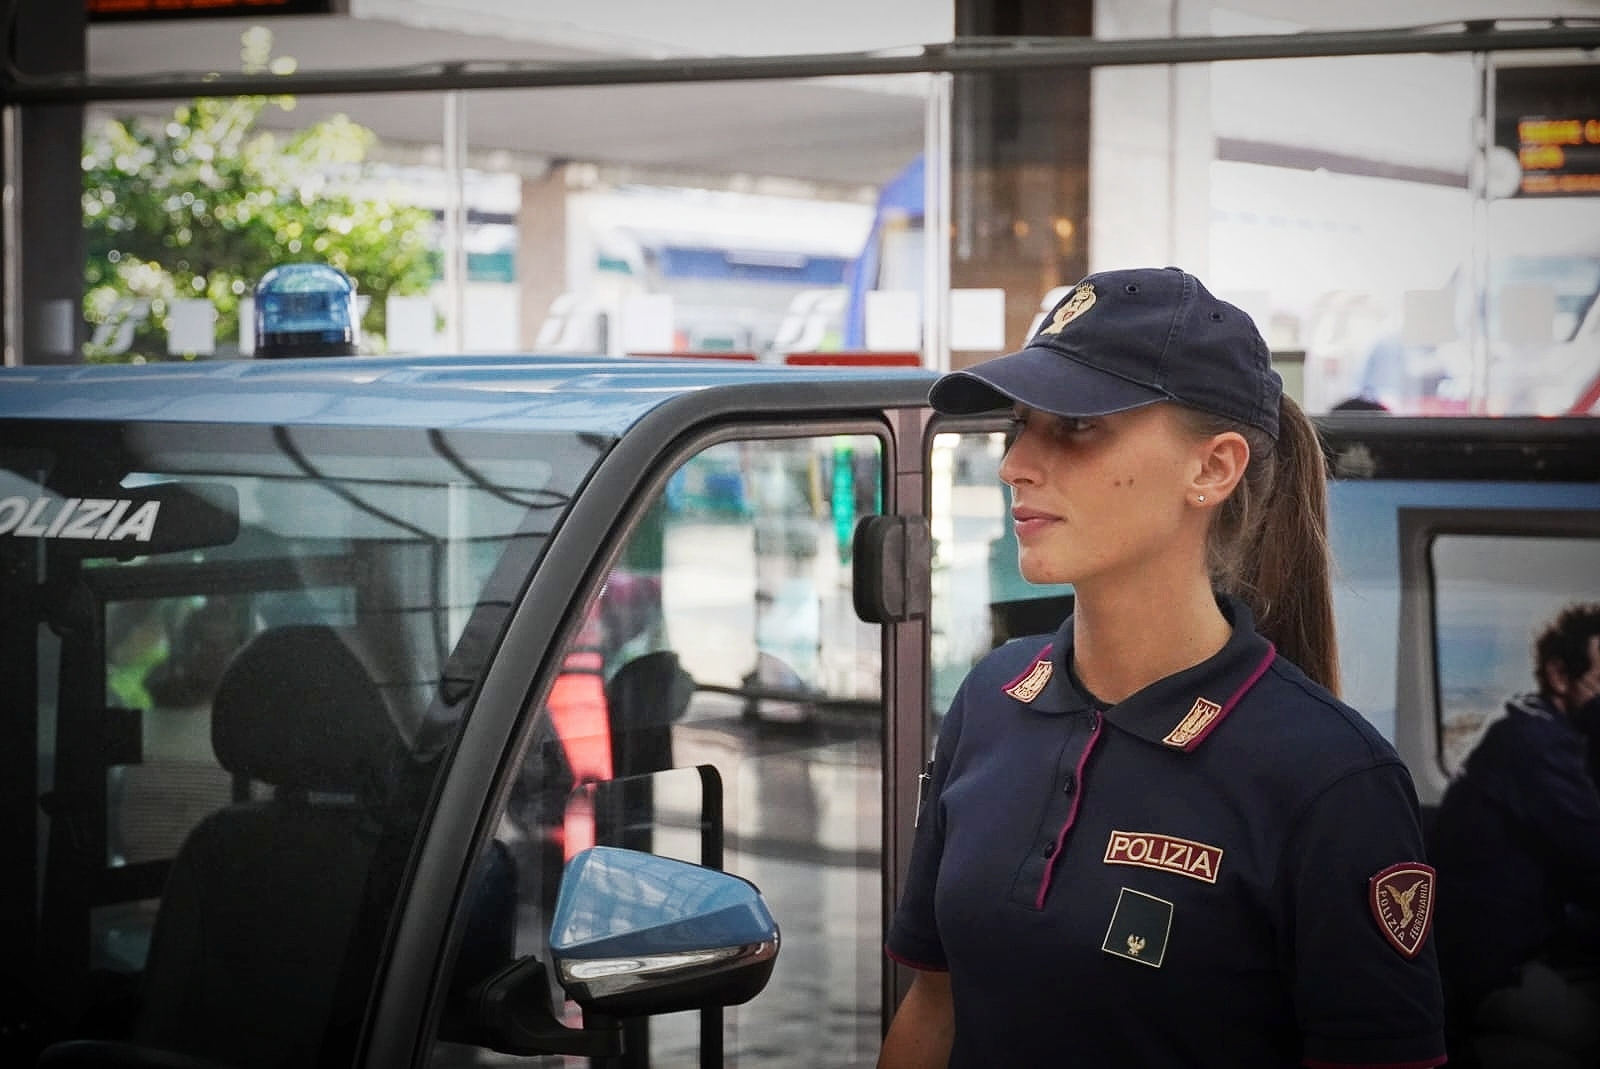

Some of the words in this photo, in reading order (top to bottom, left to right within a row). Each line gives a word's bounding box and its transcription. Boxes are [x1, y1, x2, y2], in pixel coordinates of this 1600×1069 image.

[0, 496, 161, 542] OLIZIA
[1109, 836, 1212, 878] POLIZIA
[1380, 890, 1405, 941] POLIZIA
[1409, 882, 1429, 940] FERROVIARIA
